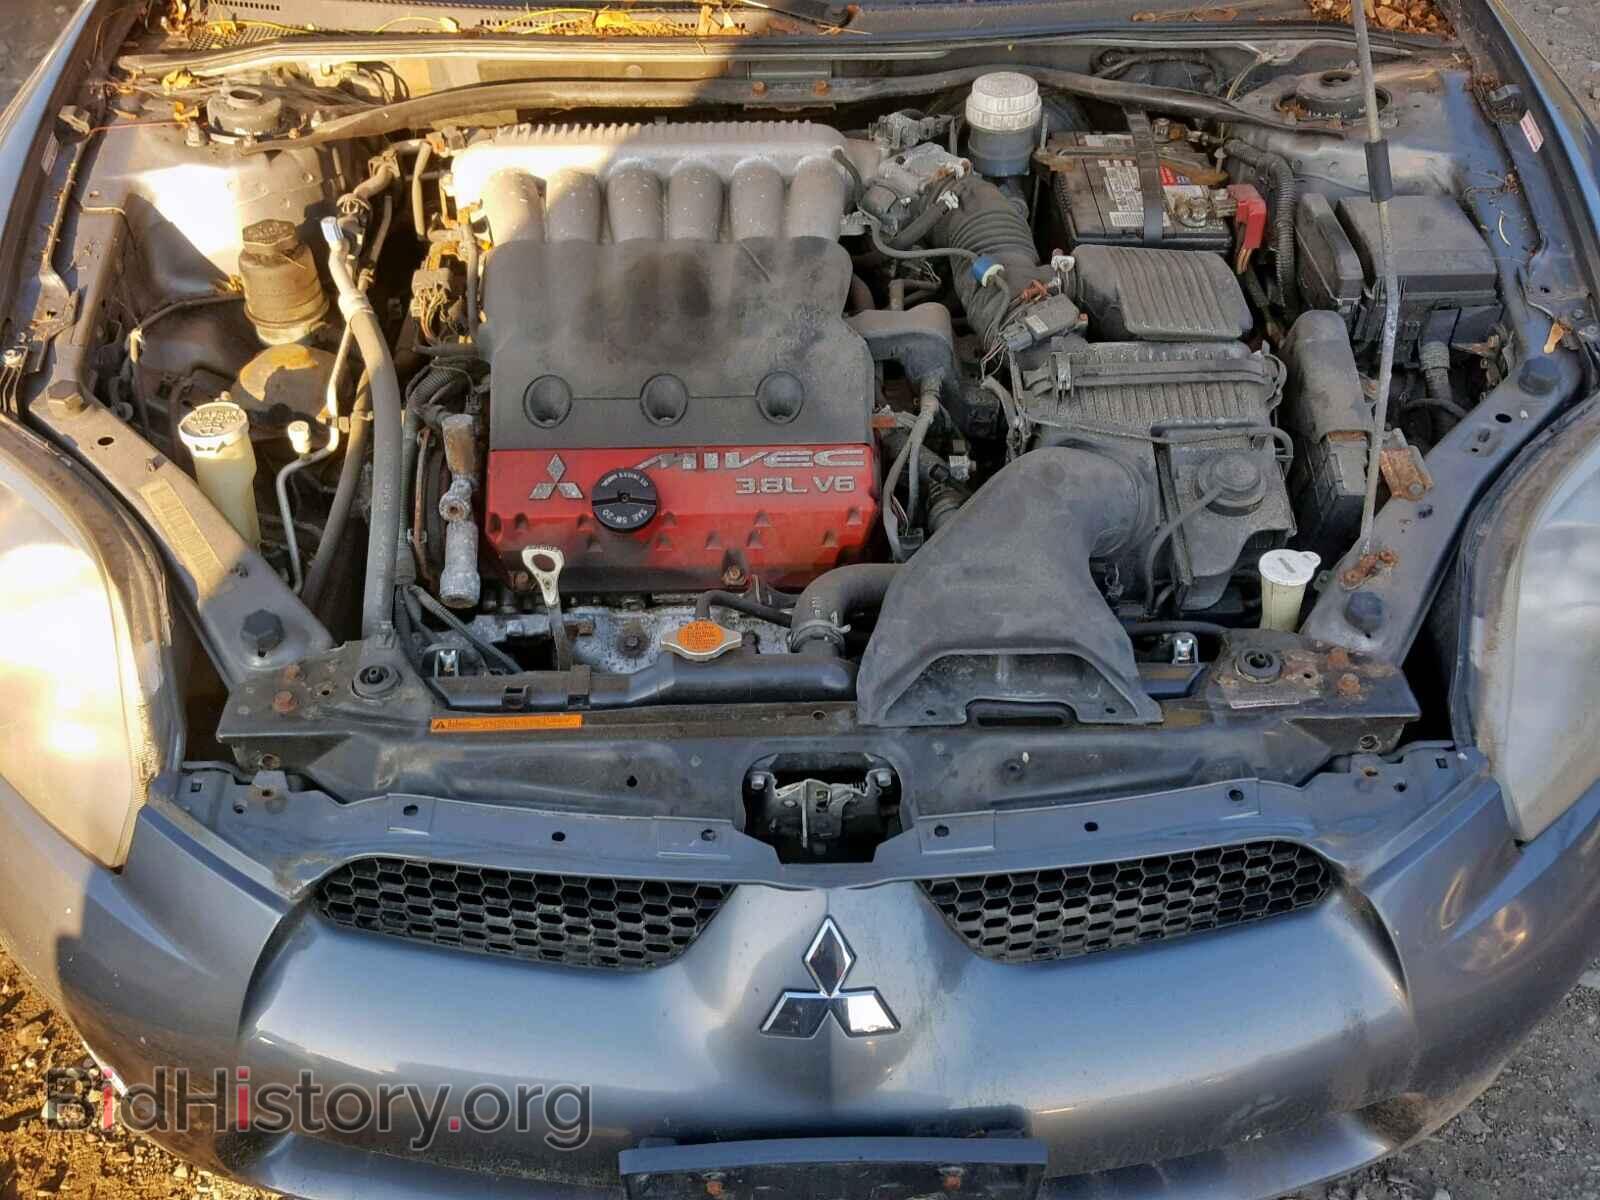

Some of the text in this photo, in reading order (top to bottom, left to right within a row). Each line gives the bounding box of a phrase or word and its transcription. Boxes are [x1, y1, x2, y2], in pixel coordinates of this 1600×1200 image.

[633, 449, 865, 469] MIVEC
[735, 474, 856, 495] 3.8L V6
